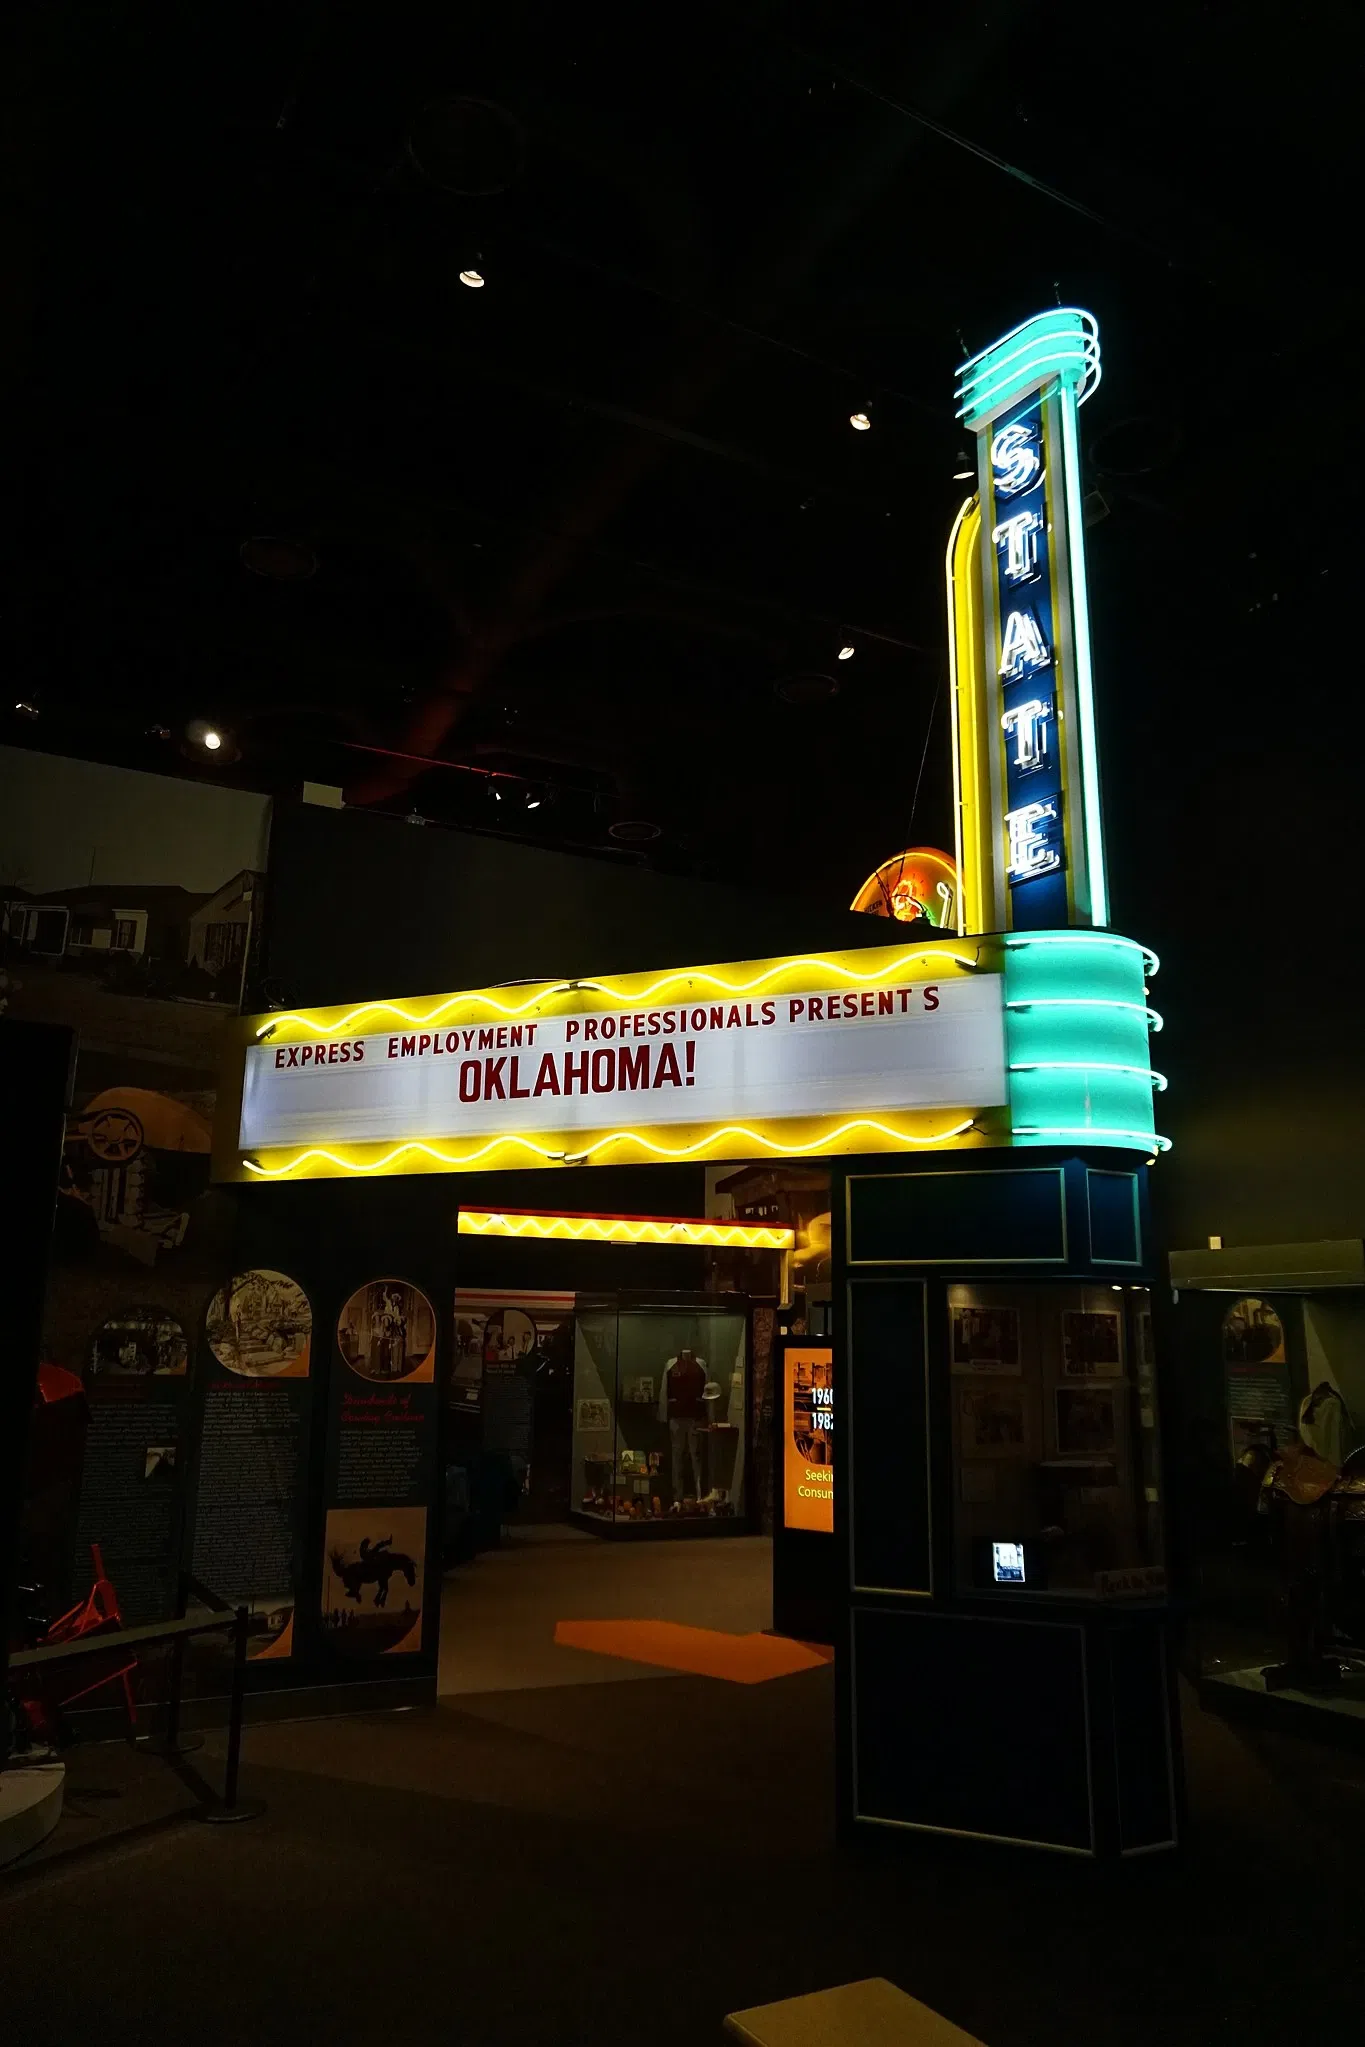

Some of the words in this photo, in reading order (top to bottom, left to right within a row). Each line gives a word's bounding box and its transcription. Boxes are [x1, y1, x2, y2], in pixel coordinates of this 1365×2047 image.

[991, 423, 1060, 885] STATE
[274, 1041, 365, 1069] EXPRESS
[387, 1023, 538, 1058] EMPLOYMENT
[565, 1000, 776, 1042] PROFESSIONALS
[458, 1040, 697, 1103] OKLAHOMA!
